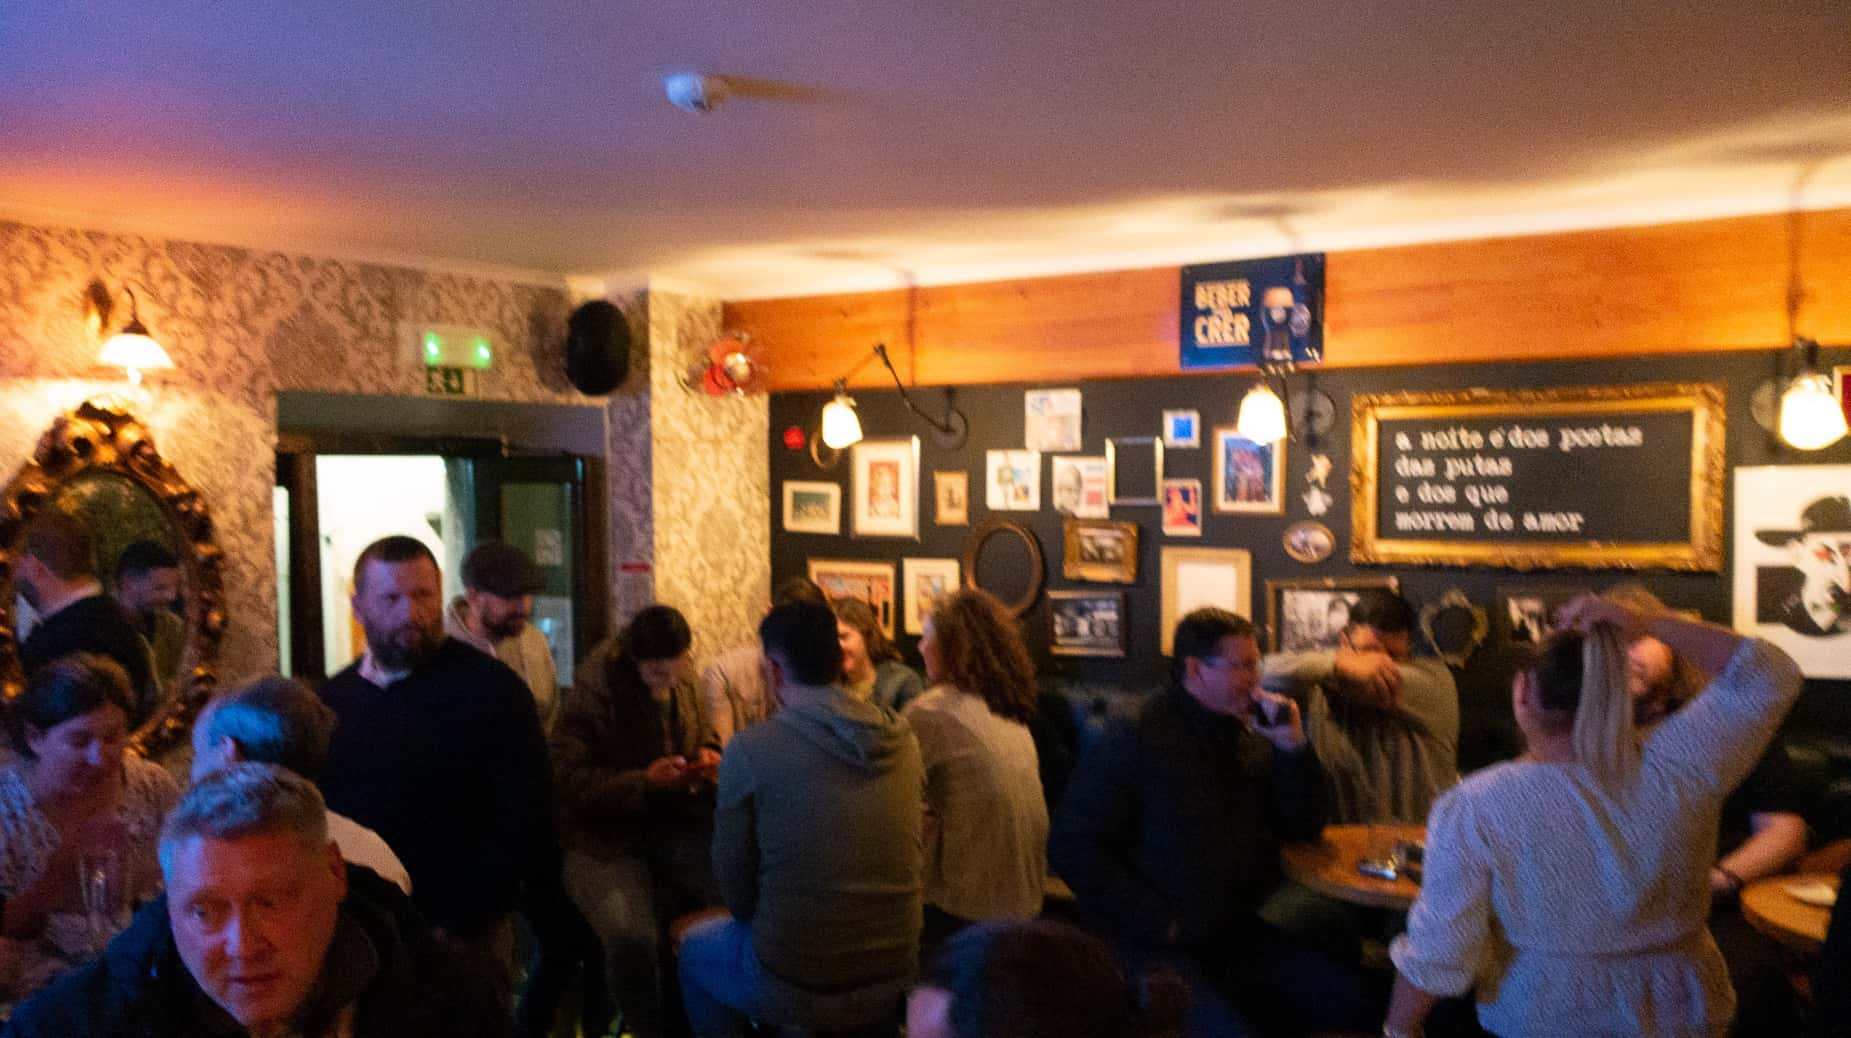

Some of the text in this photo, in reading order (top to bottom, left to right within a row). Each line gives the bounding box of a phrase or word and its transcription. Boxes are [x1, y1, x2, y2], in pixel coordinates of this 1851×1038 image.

[1395, 431, 1412, 450] a
[1421, 427, 1484, 450] noite
[1508, 424, 1550, 449] dos
[1560, 423, 1644, 451] poetas
[1395, 453, 1513, 480] das putas
[1395, 481, 1510, 508] e dos que
[1395, 507, 1584, 532] morrem de amor
